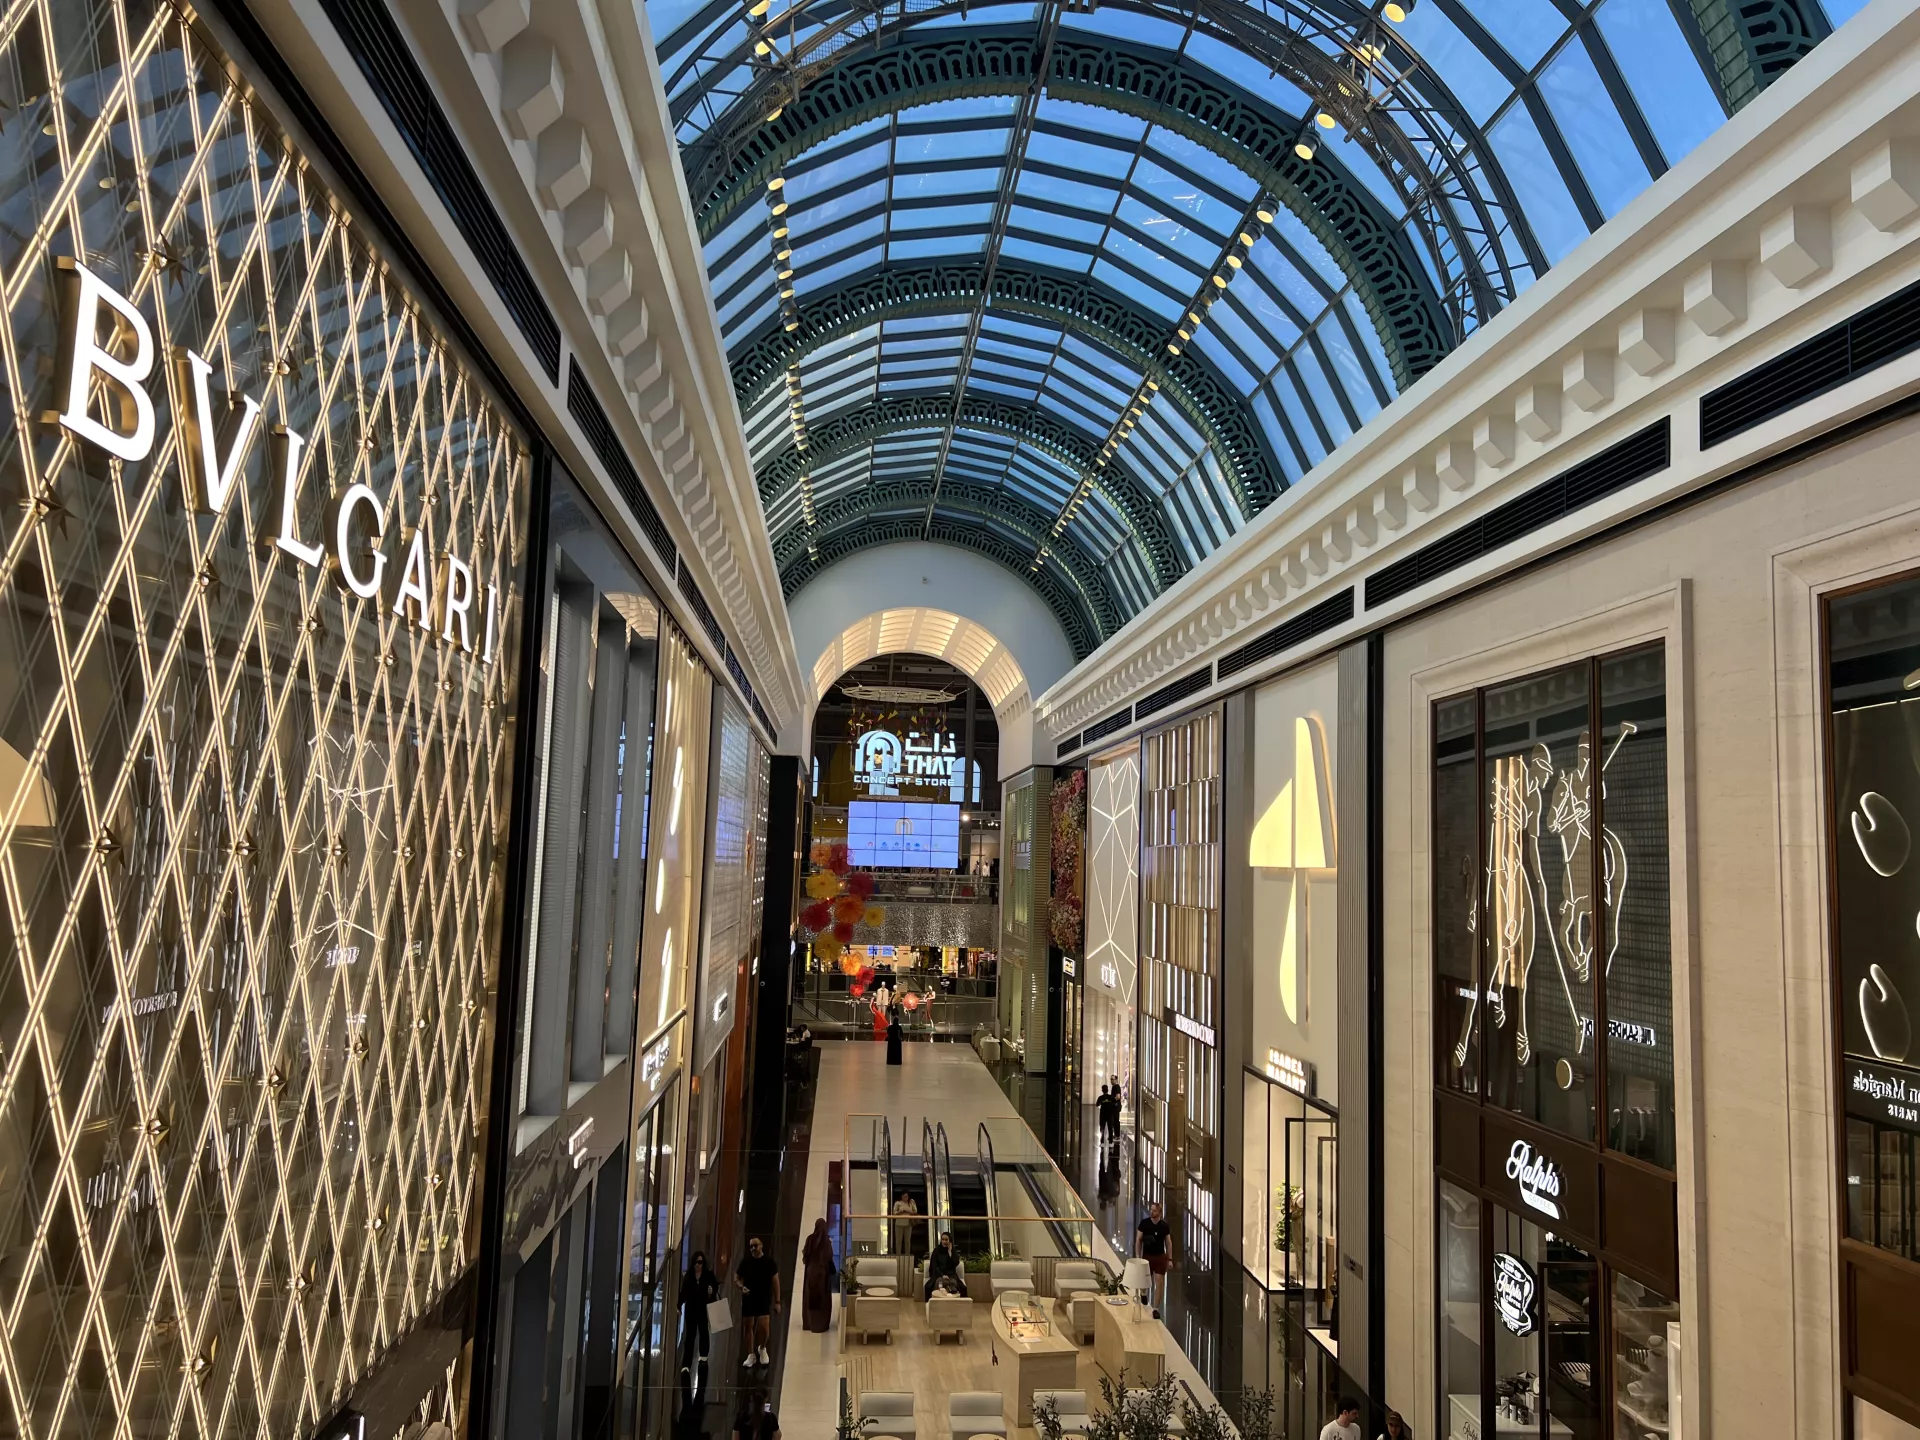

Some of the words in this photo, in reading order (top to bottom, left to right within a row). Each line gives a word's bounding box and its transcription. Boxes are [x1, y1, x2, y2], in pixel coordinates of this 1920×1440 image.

[56, 258, 497, 665] BVLGARI
[905, 731, 957, 754] ذات
[904, 754, 956, 776] THAT
[853, 774, 911, 786] CONCEPT
[914, 777, 955, 787] STORE
[1506, 1139, 1559, 1197] Ralph's
